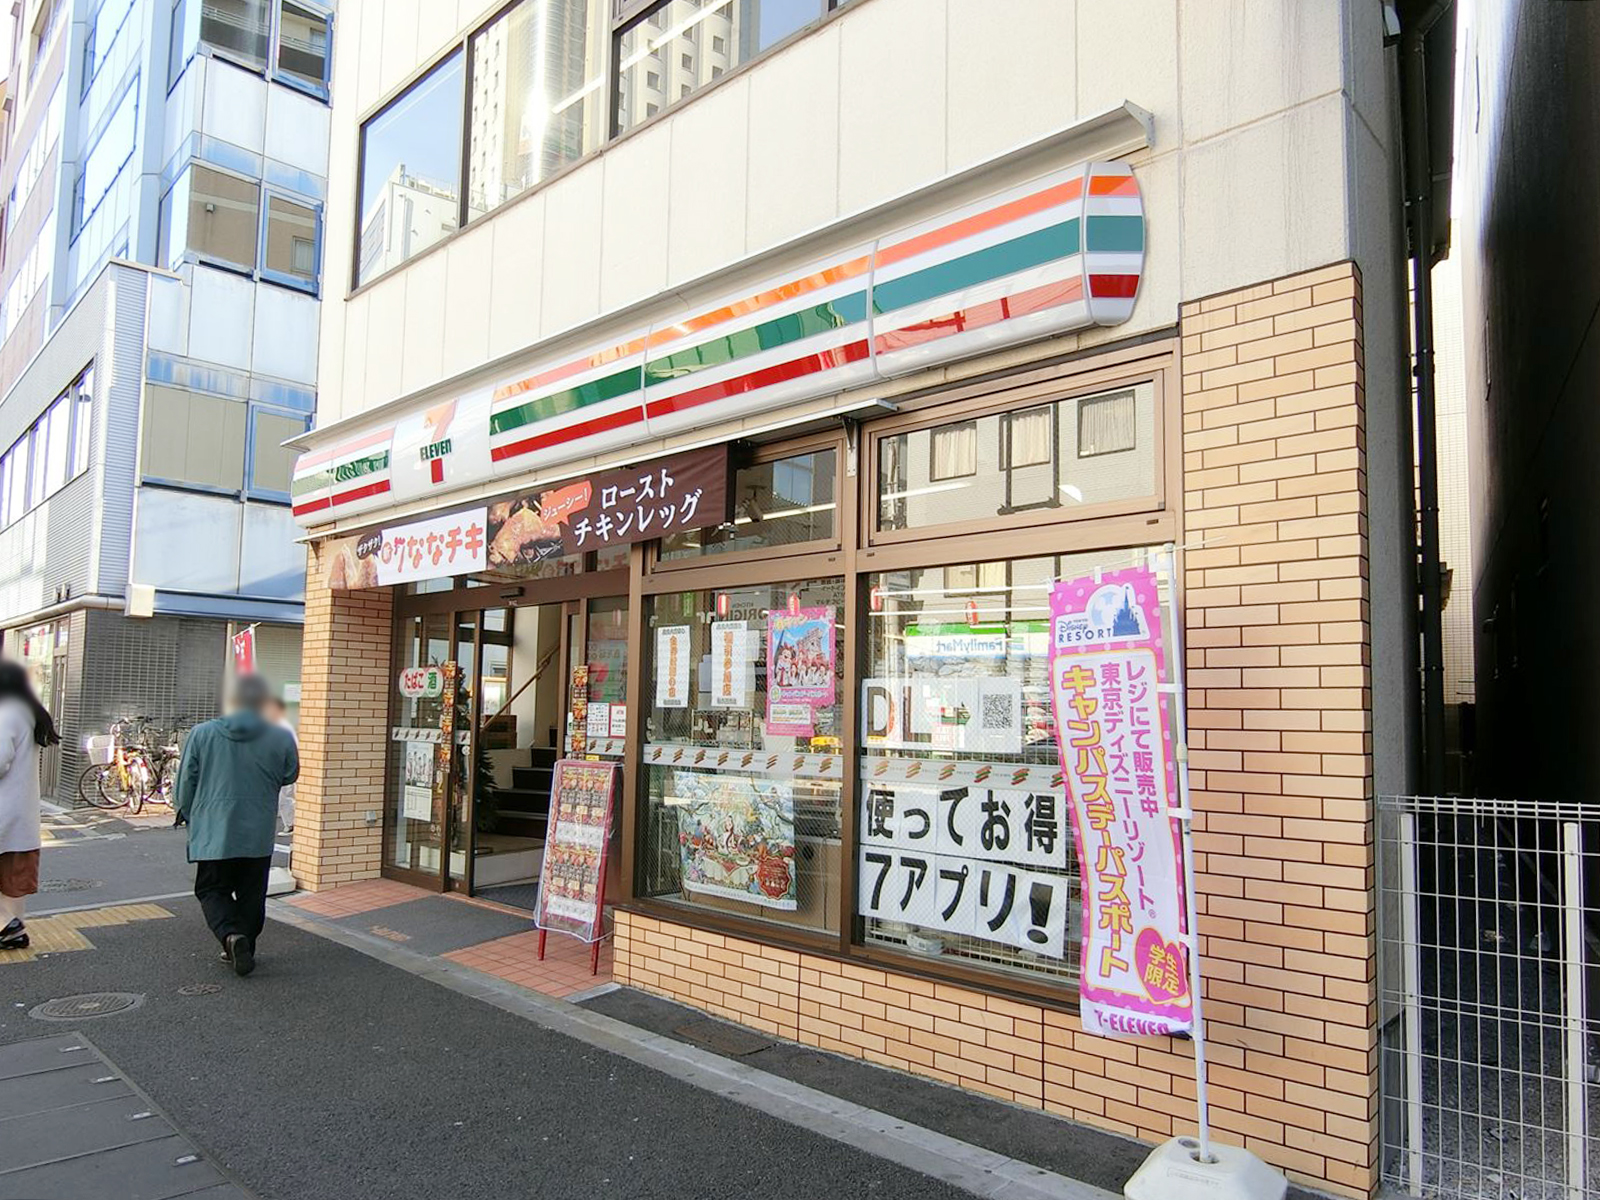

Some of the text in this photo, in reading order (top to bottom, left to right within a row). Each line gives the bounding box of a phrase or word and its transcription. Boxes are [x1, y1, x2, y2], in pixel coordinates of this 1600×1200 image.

[574, 488, 703, 547] チキンレッグ
[602, 467, 674, 509] ロースト
[1058, 628, 1112, 643] RESORT
[1126, 659, 1159, 818] レジにて販売中
[866, 786, 1058, 855] 使ってお得
[1062, 665, 1134, 978] キャンパスデーパスポート
[865, 852, 1055, 945] 7アプリ!
[1144, 963, 1180, 996] 限定
